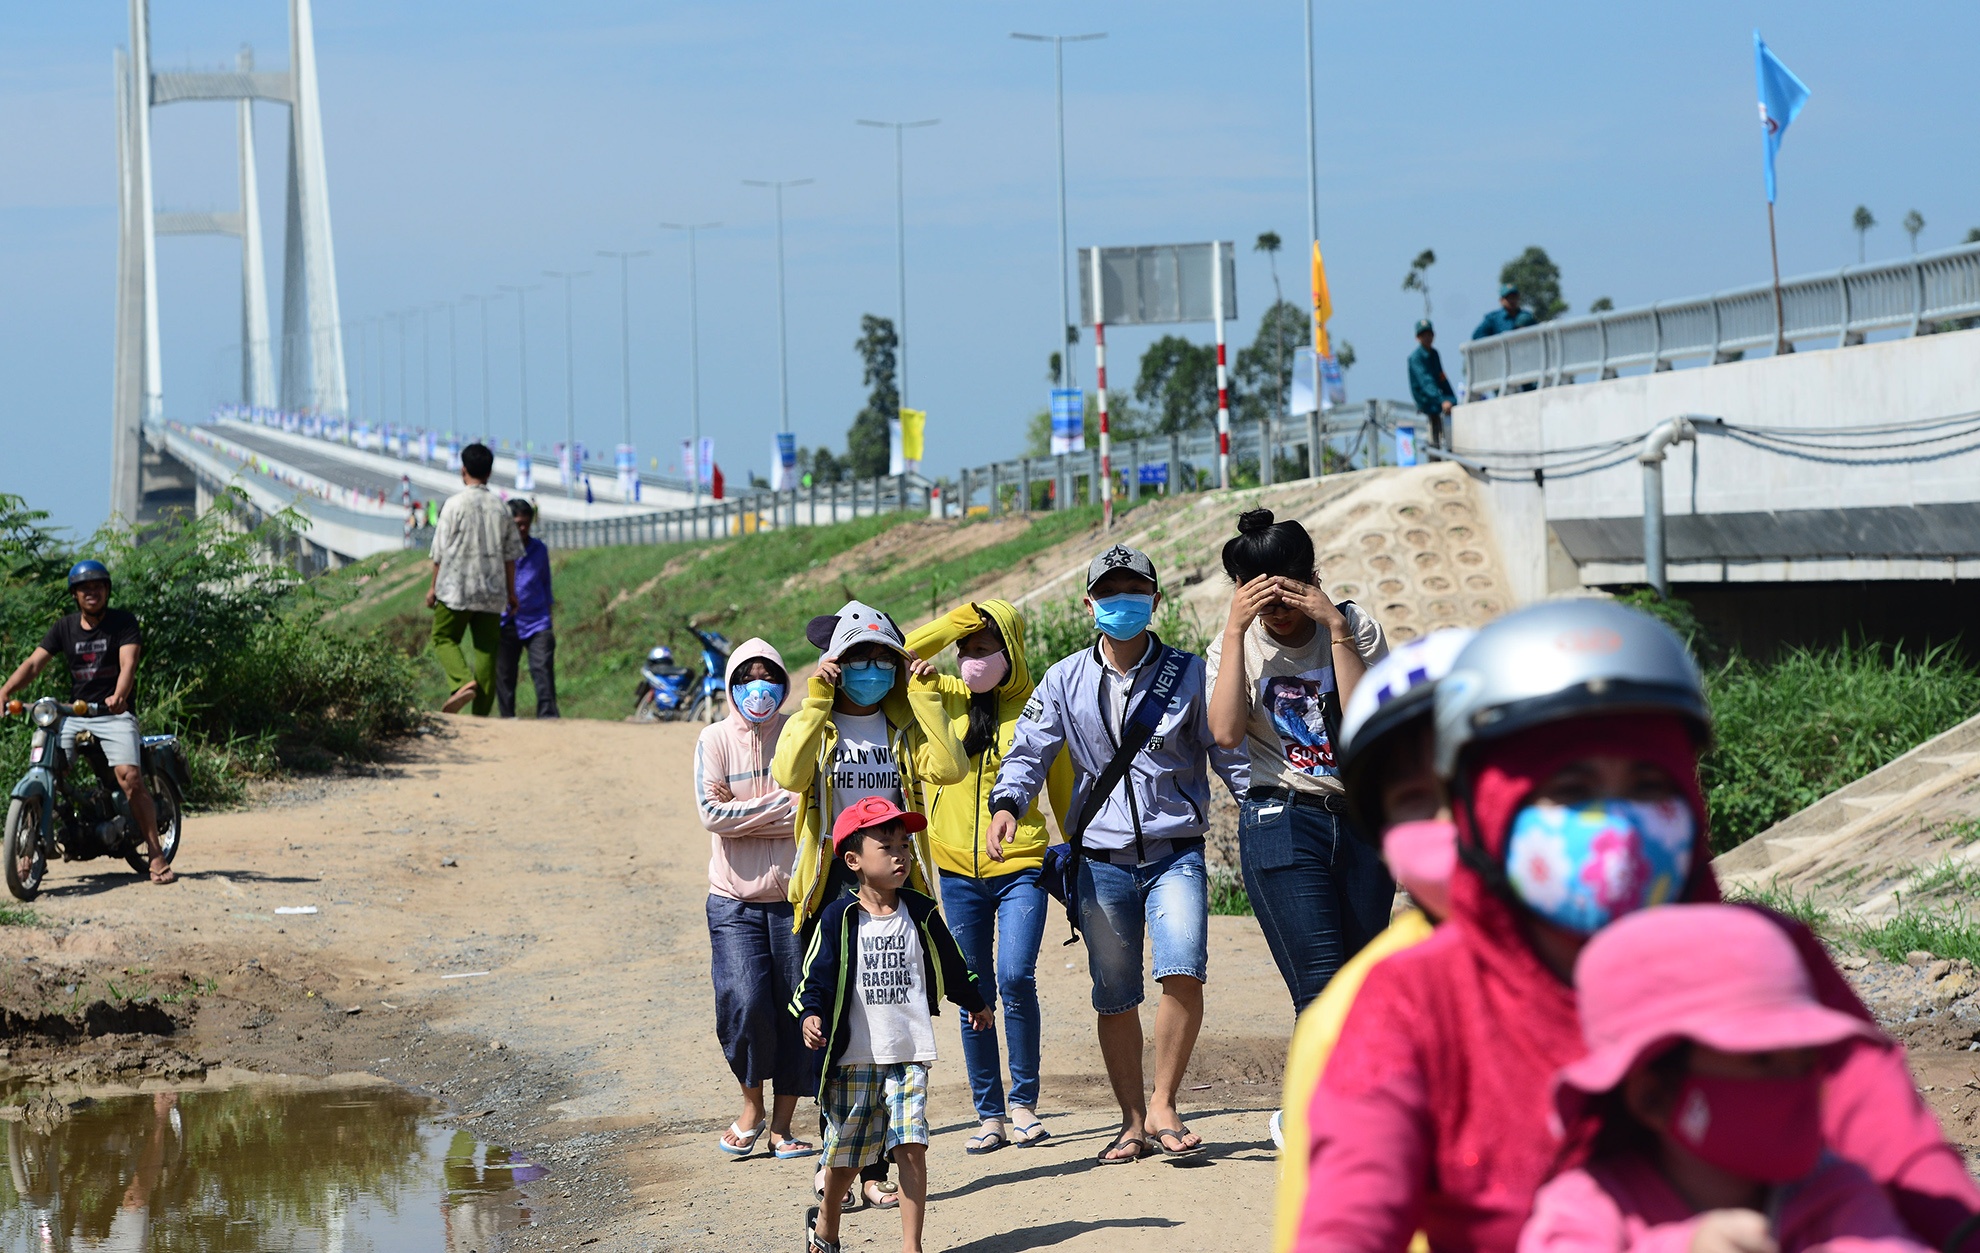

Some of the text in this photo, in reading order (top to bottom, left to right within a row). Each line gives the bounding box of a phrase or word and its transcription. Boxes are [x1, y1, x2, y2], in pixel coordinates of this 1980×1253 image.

[1153, 661, 1179, 698] NEW
[832, 772, 853, 788] THE
[861, 935, 906, 951] WORLD
[863, 952, 906, 969] WIDE
[862, 971, 912, 988] RACING
[865, 988, 911, 1005] M.BLACK
